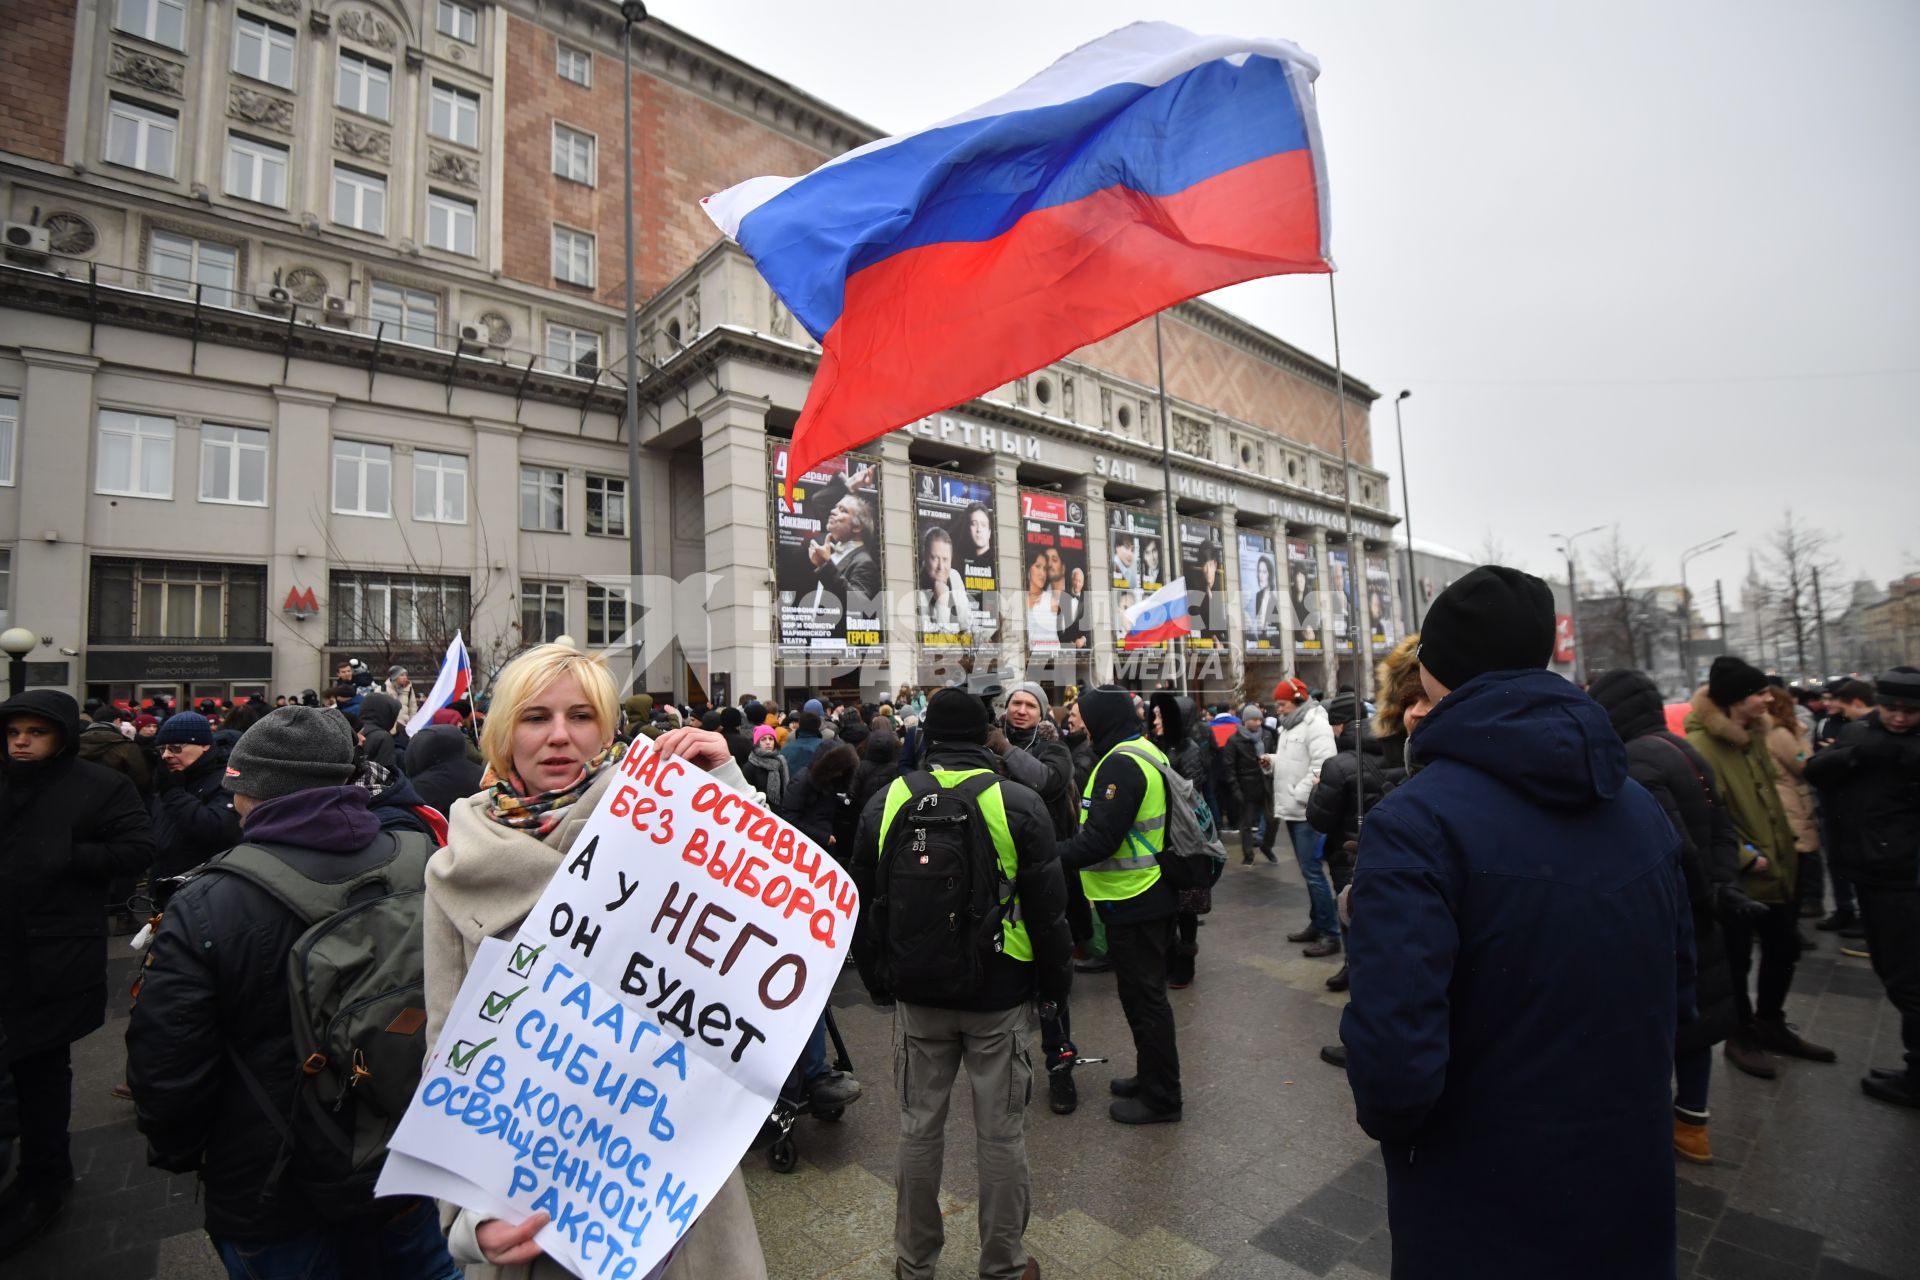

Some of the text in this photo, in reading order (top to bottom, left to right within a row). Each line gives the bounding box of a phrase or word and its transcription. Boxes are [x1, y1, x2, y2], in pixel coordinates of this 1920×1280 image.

[907, 415, 1382, 539] ЕРТНЫЙ ЗАЛ ИМЕНИ П.И.ЧАЙКОВКОГО
[943, 482, 951, 504] 1
[1023, 496, 1032, 516] 7
[148, 654, 219, 663] МОСКОВСКИЙ
[782, 629, 832, 637] МАРИИНСКОГО
[847, 631, 880, 645] ГЕРГИЕВ
[145, 667, 221, 675] МЕТРОПОЛИТЕН
[620, 739, 685, 797] НАС
[549, 902, 601, 958] ОН
[568, 835, 807, 1010] А У НЕГО
[542, 962, 687, 1082] ГААГА
[515, 1009, 675, 1142] СИБИРЬ
[475, 1054, 699, 1238] В КОСМОС НА
